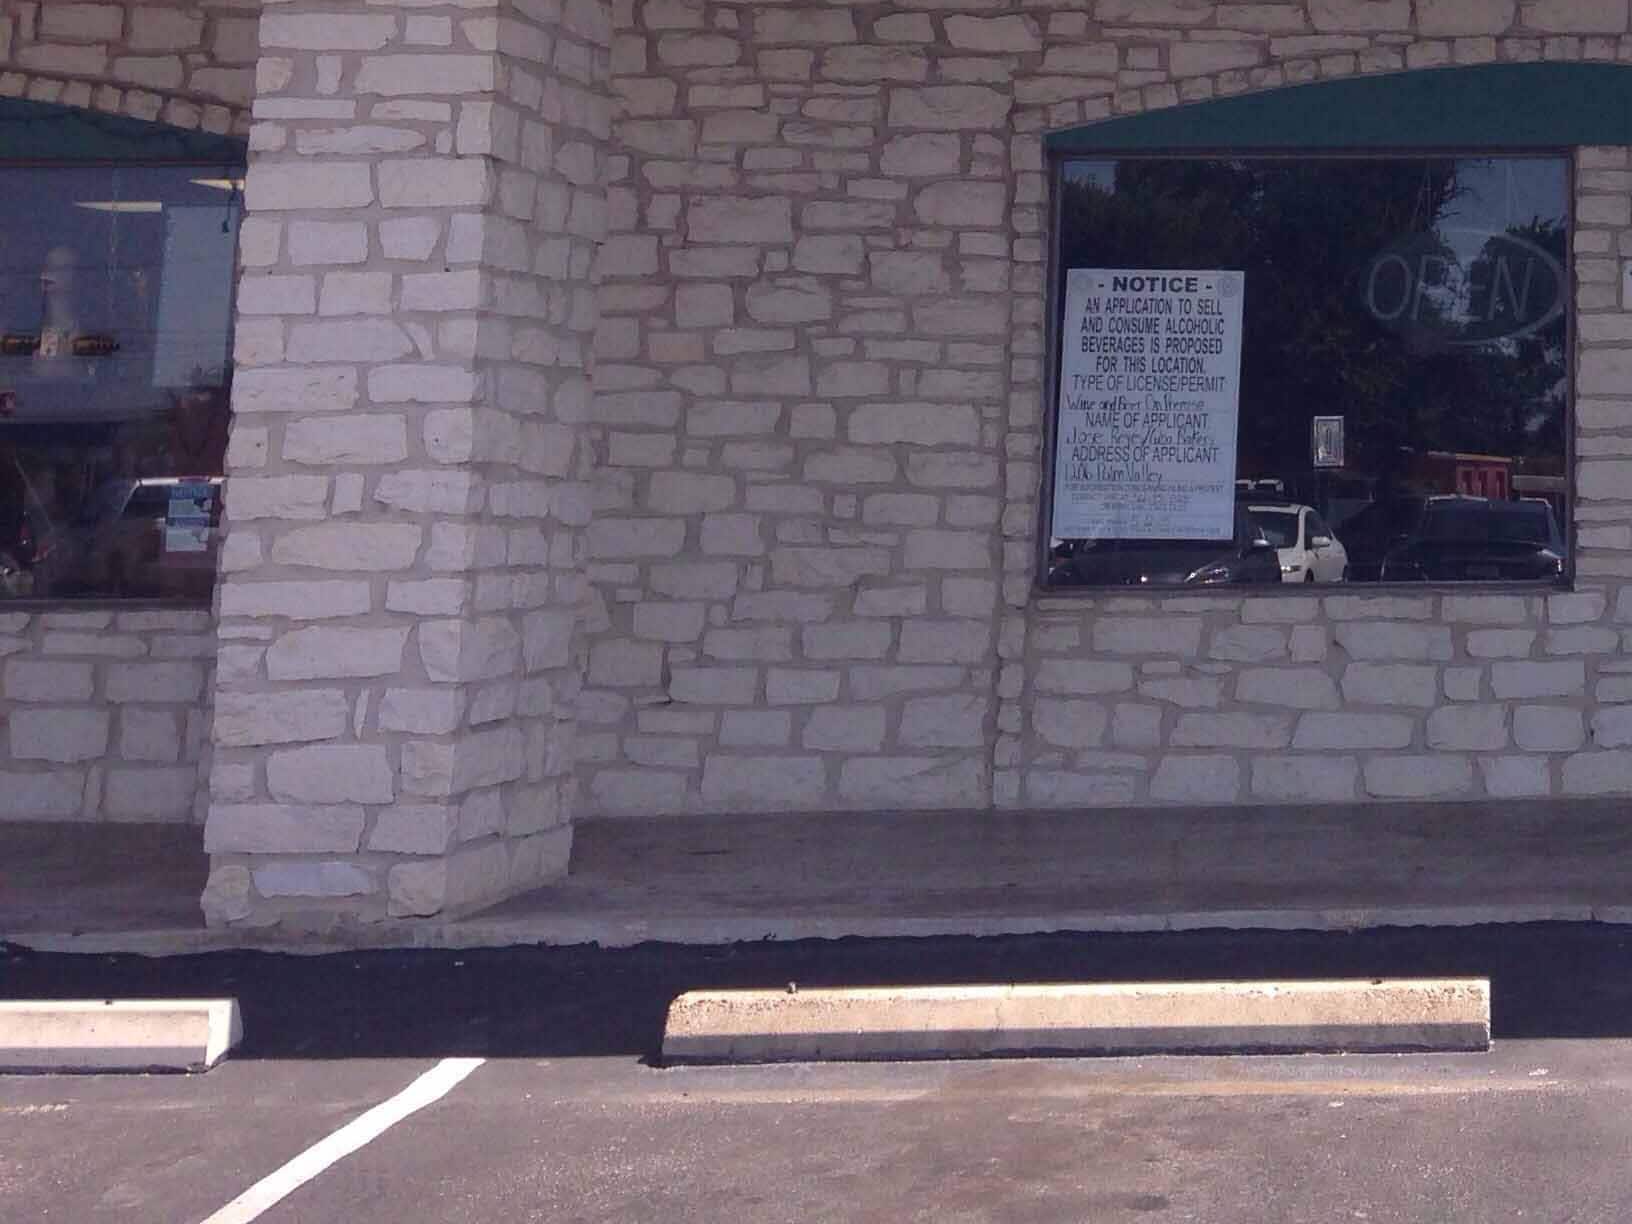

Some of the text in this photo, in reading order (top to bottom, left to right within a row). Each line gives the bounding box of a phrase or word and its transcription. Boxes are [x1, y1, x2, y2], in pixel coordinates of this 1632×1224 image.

[1112, 276, 1198, 293] NOTICE
[1086, 298, 1222, 315] AN APPLICATION TO SELL
[1081, 317, 1225, 335] AND CONSUME ALCOHOLIC
[1082, 336, 1223, 354] BEVERAGES IS PROPOSED
[1096, 356, 1117, 372] FOR
[1124, 357, 1145, 372] THIS
[1073, 374, 1103, 391] TYPE
[1107, 375, 1124, 392] OF
[1086, 413, 1208, 429] NAME OF APPLICANT
[1072, 446, 1219, 463] ADDRESS OF APPLICANT
